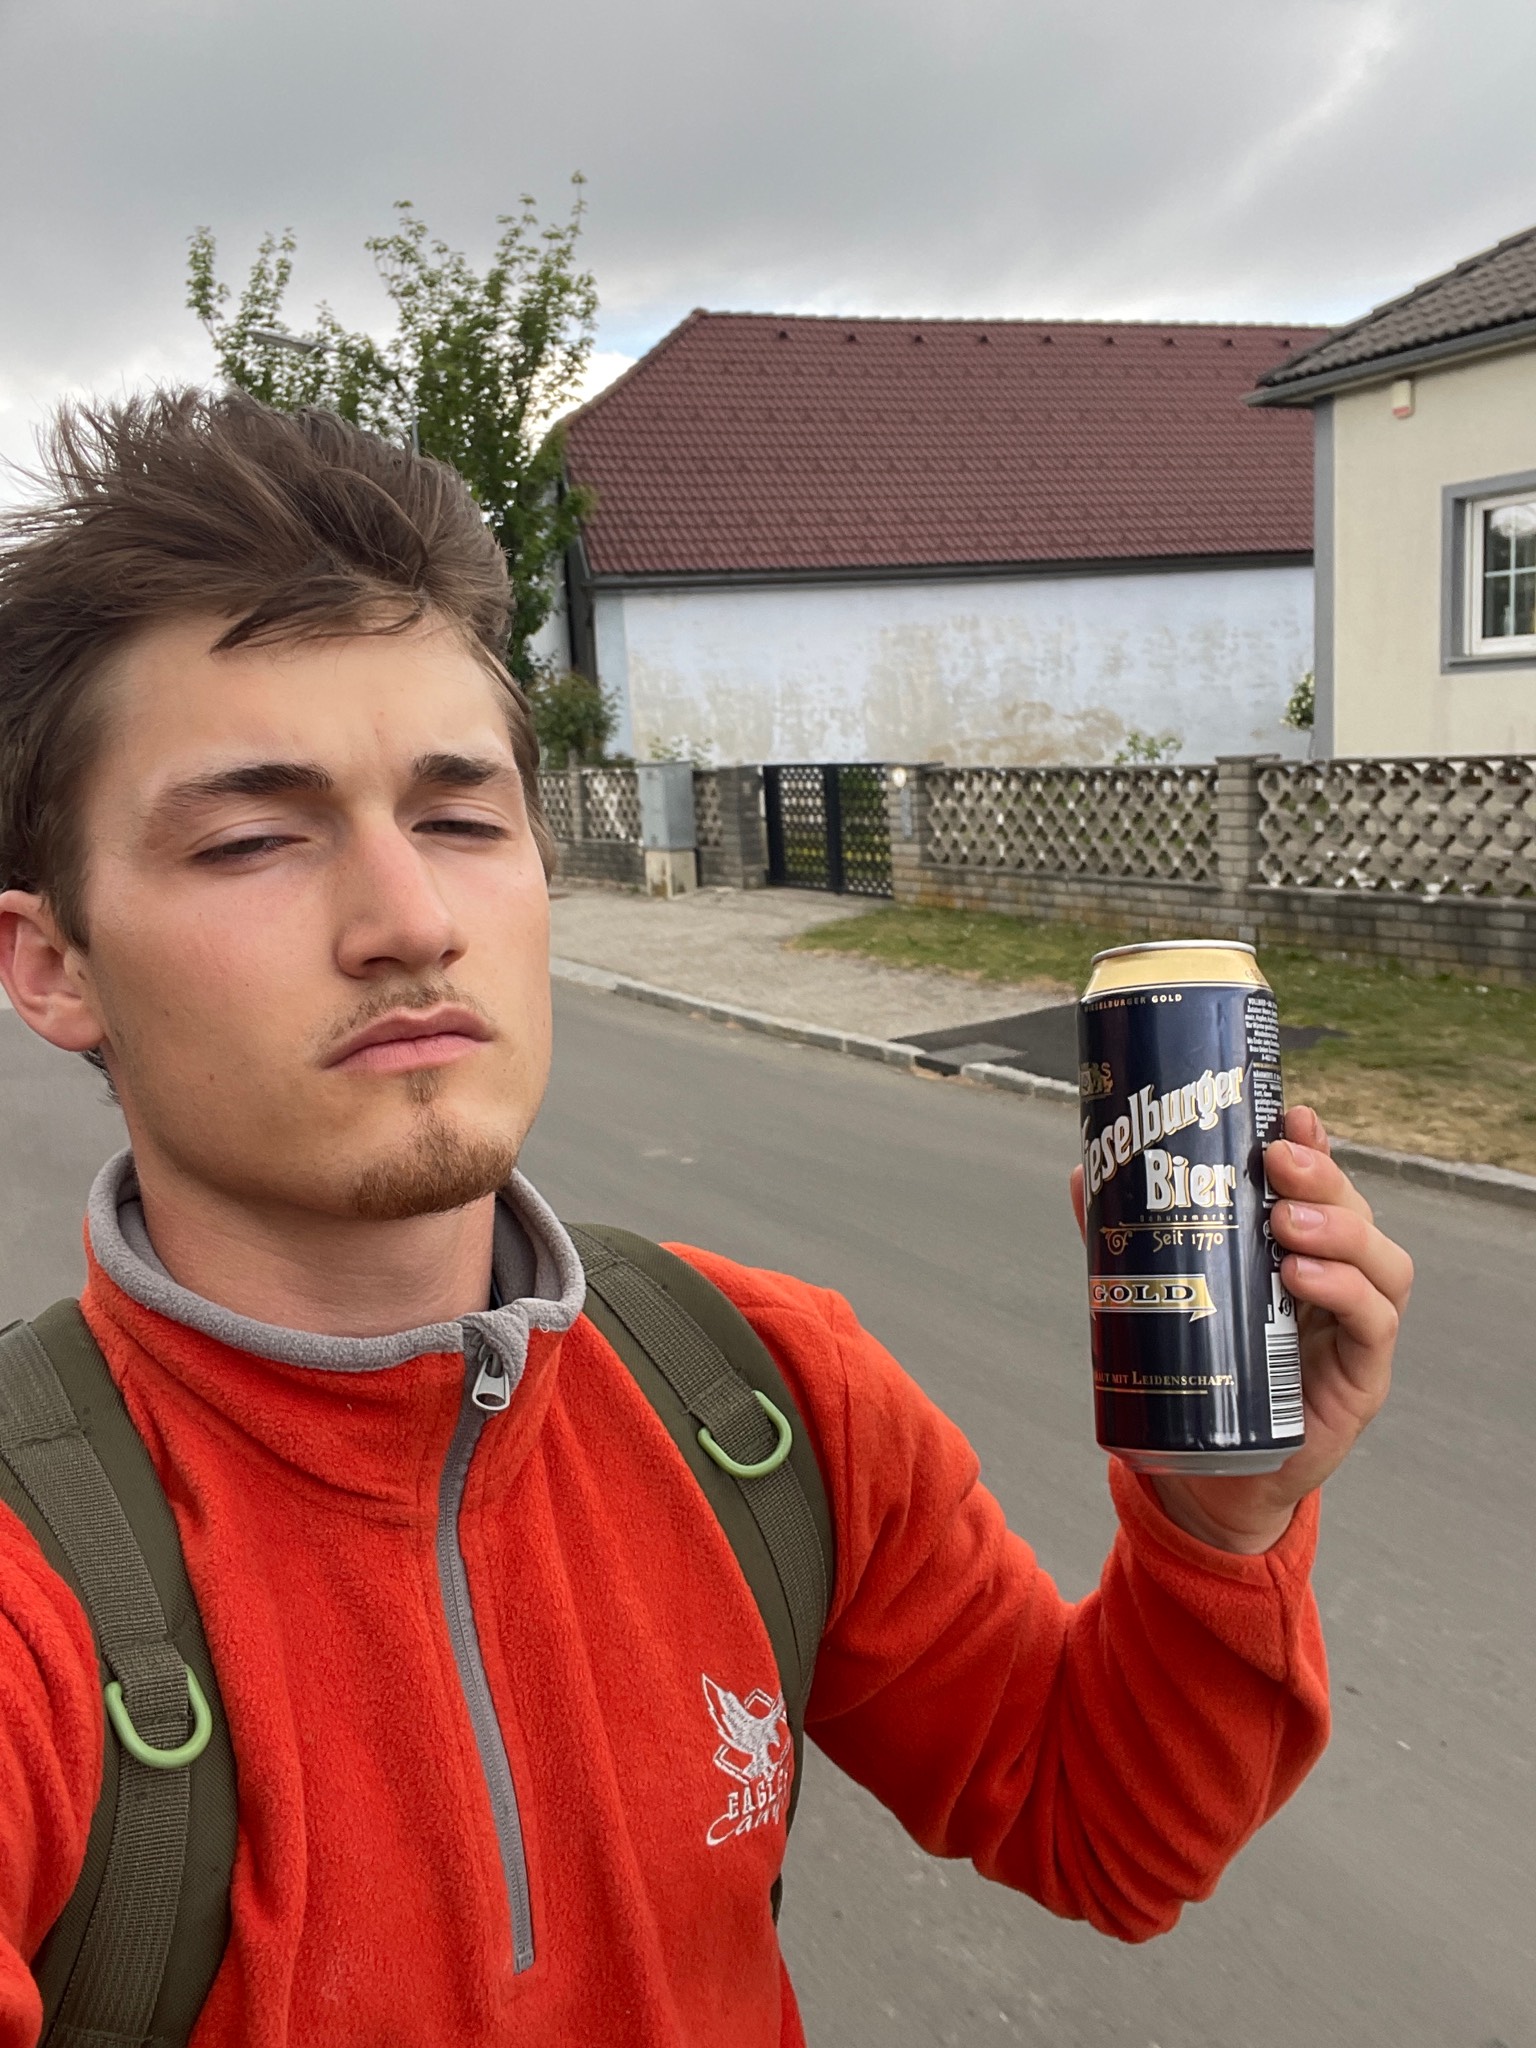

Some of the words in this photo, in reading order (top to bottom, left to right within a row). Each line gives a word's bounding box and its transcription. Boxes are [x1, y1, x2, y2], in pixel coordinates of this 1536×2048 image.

[1151, 993, 1183, 1003] GOLD
[1144, 1148, 1237, 1211] Bier
[1152, 1230, 1184, 1253] Seit
[1191, 1232, 1225, 1251] 1770
[1091, 1282, 1195, 1304] GOLD
